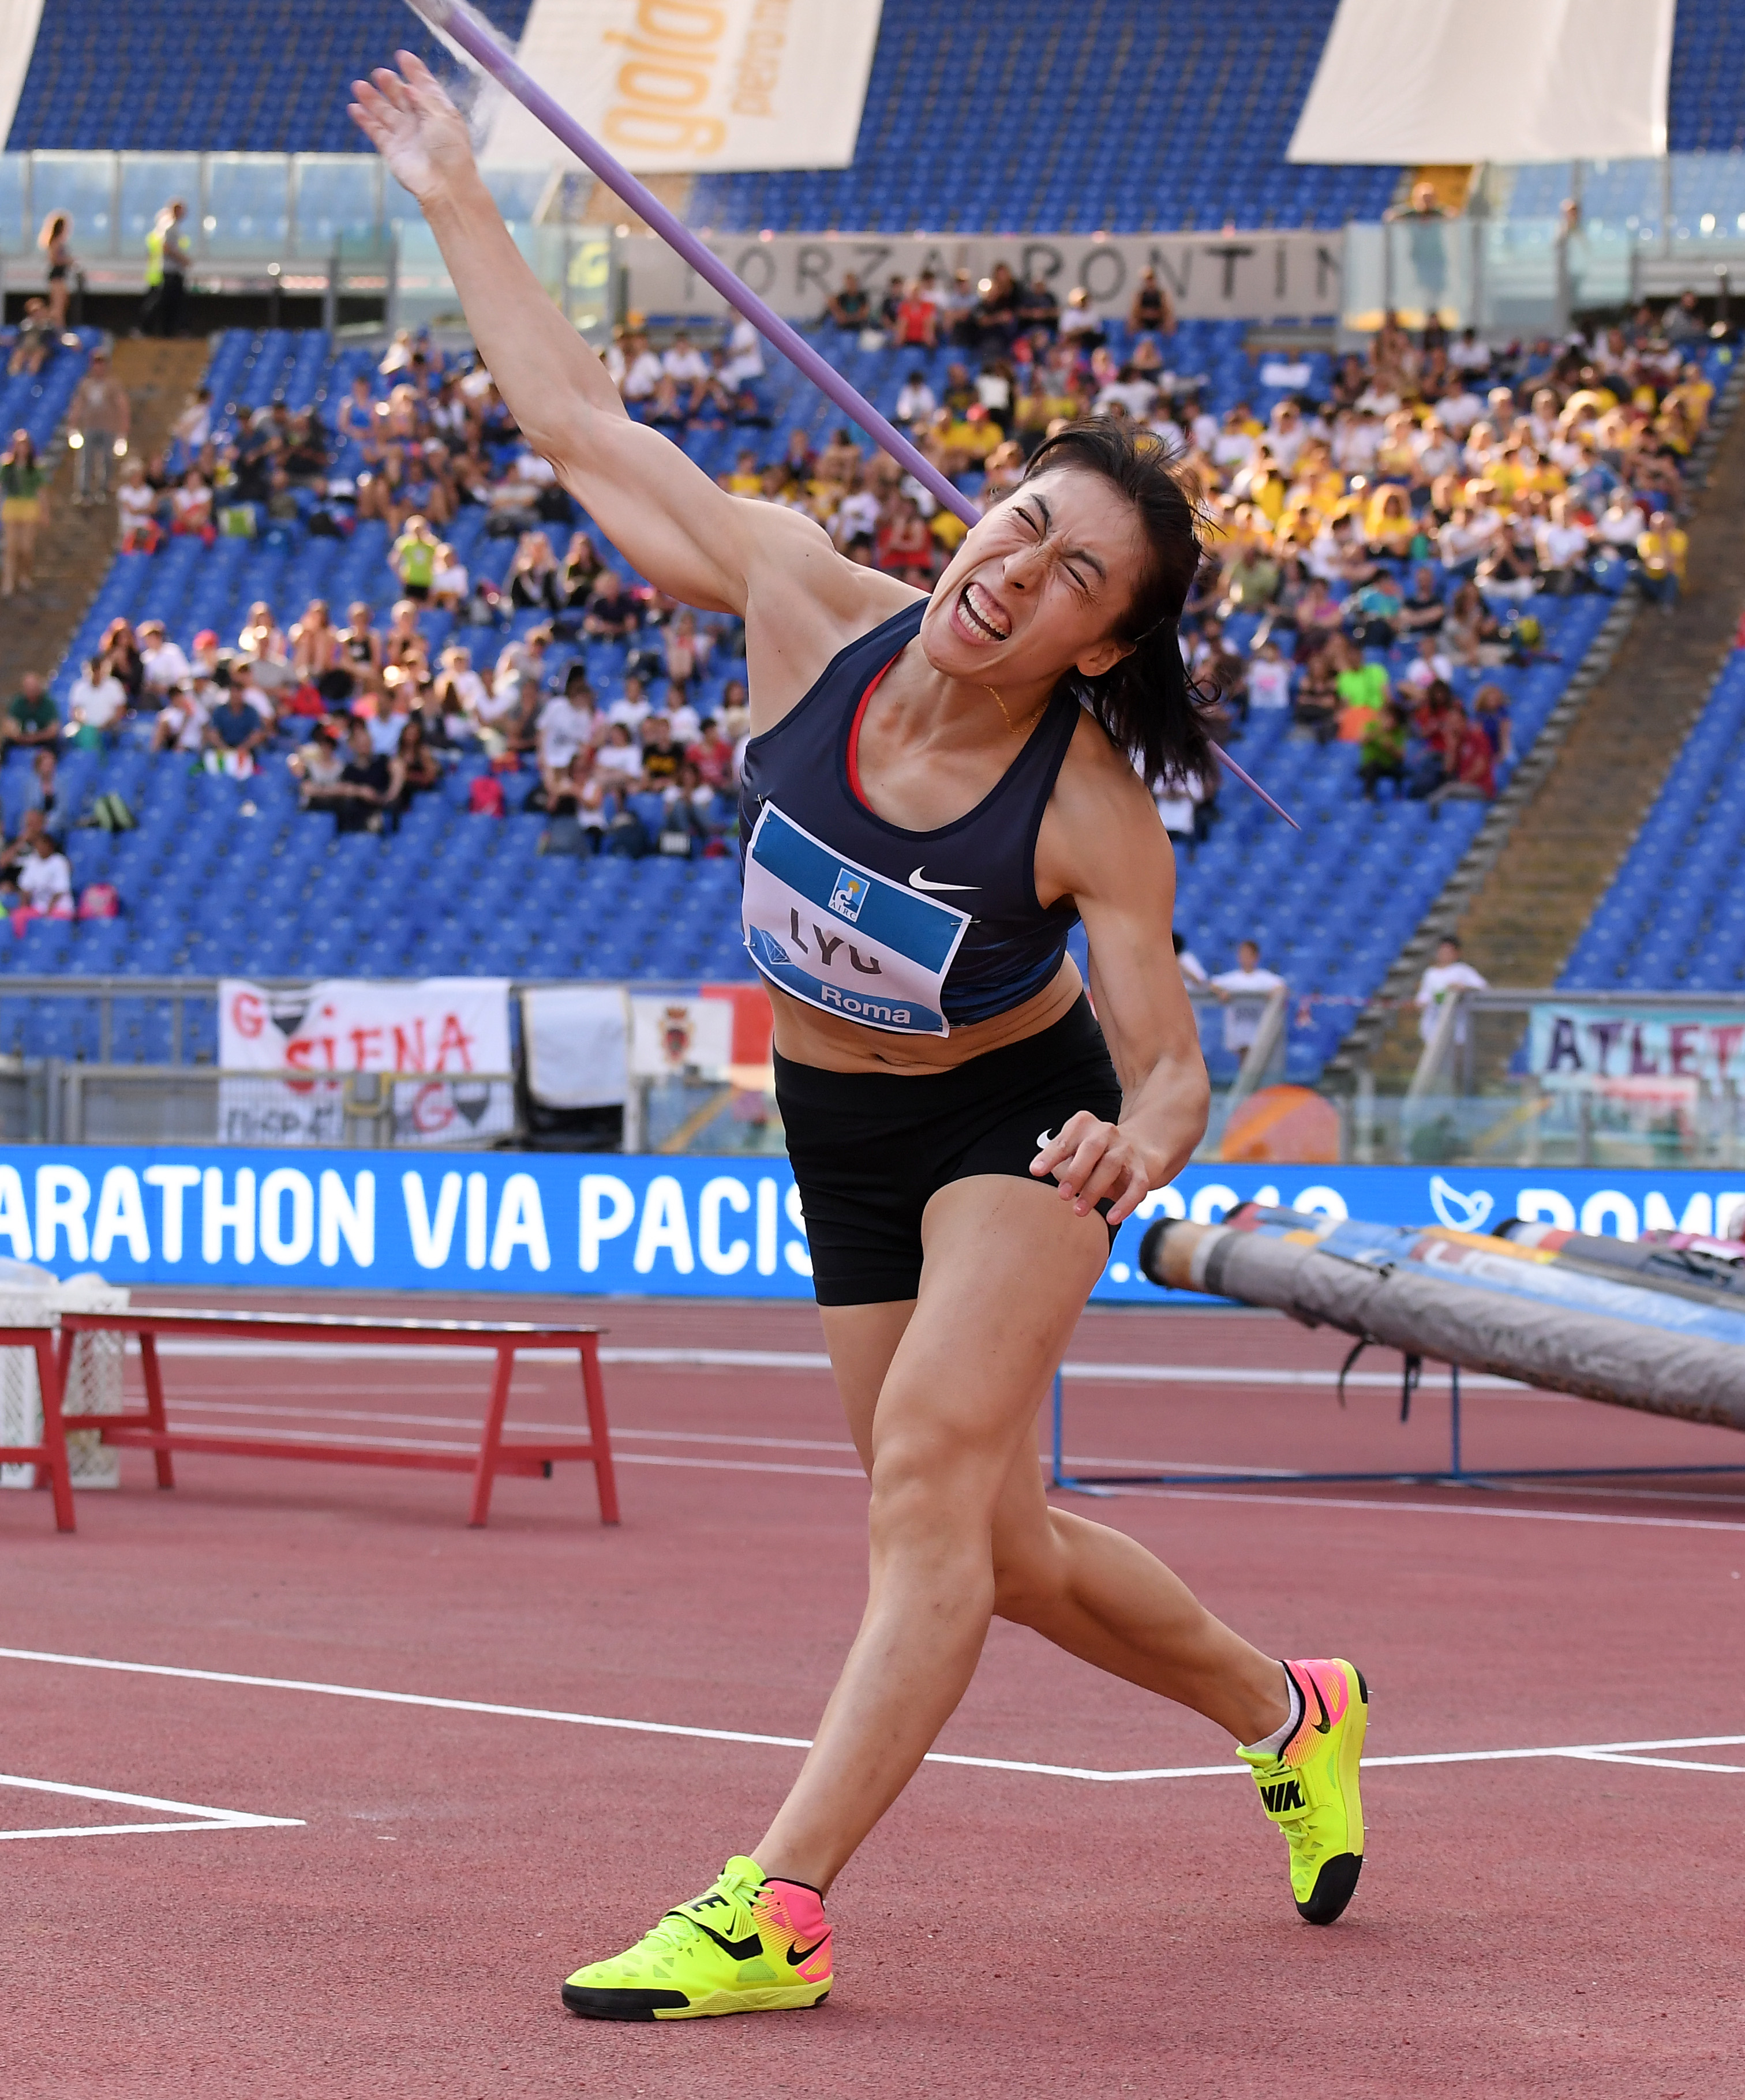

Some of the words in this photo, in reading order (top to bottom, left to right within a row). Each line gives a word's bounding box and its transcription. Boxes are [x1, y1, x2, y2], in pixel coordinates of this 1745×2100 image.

[830, 902, 857, 920] AIRC
[790, 907, 882, 974] LYU
[821, 984, 911, 1025] Roma
[0, 1164, 376, 1267] ARATHON
[402, 1171, 551, 1272] VIA
[1260, 1779, 1306, 1813] NIK
